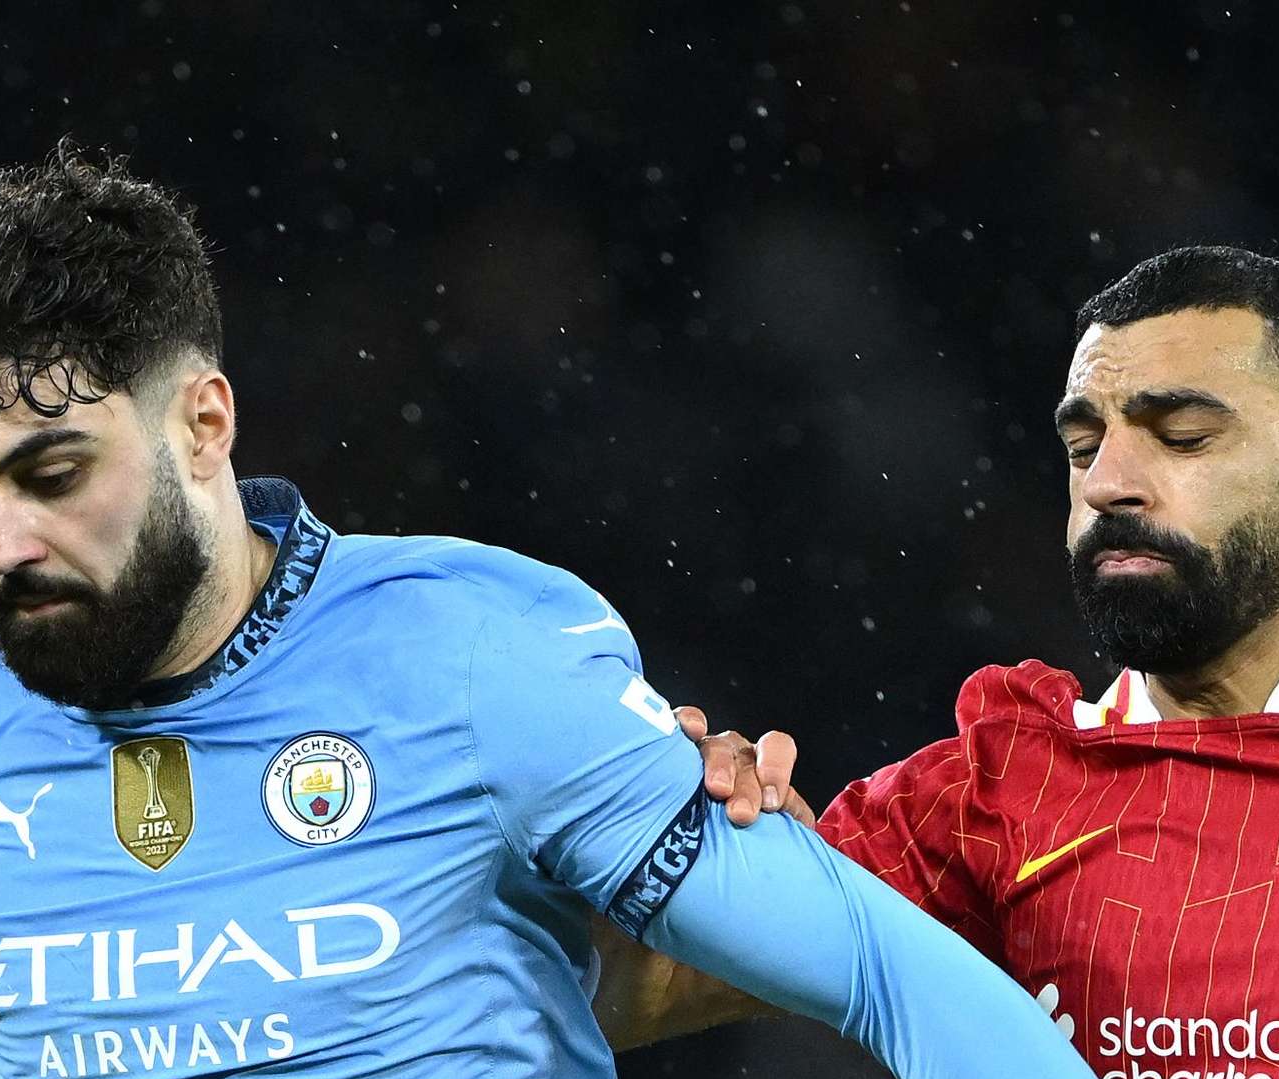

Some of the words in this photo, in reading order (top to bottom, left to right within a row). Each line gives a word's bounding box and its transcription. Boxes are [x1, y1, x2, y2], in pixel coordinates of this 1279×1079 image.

[274, 740, 362, 778] MANCHESTER
[138, 819, 174, 839] FIFA
[307, 827, 339, 840] CITY
[145, 844, 167, 856] 2023
[40, 1012, 295, 1079] AIRWAYS
